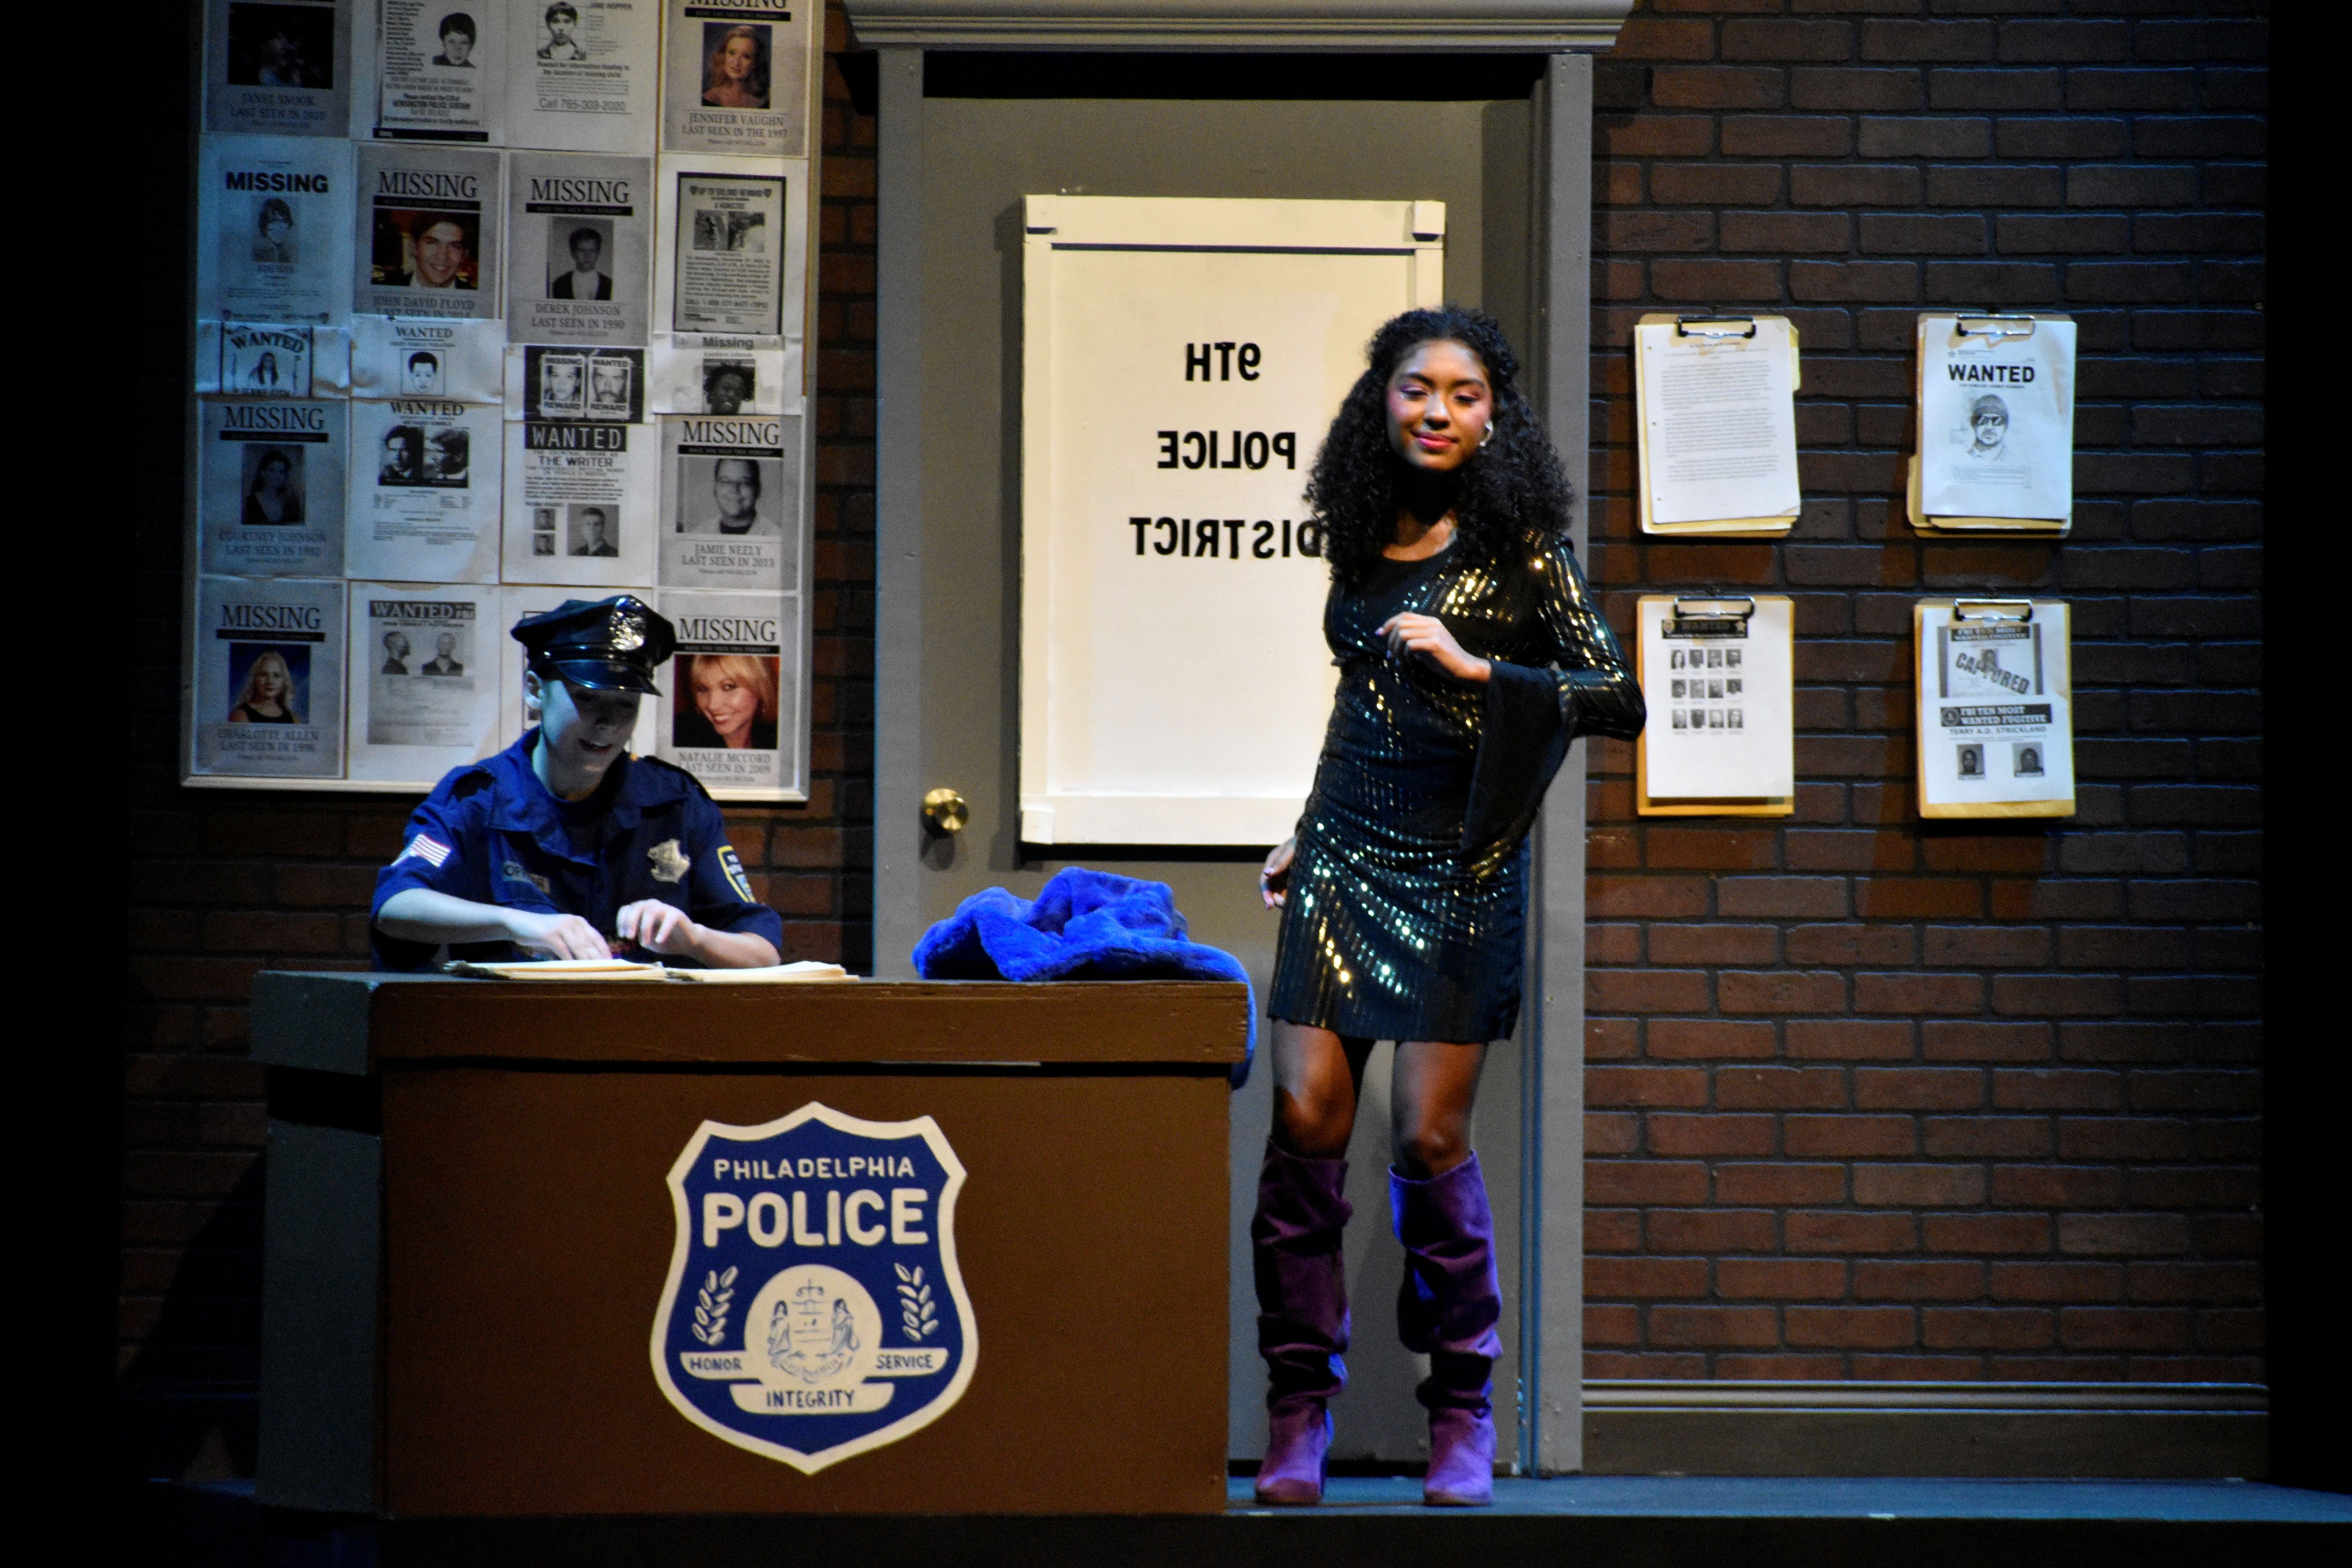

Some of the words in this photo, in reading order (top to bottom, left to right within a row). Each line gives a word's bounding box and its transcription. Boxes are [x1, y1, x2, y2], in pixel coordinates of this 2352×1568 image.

[230, 105, 255, 117] LAST
[259, 108, 285, 118] SEEN
[289, 109, 300, 119] IN
[690, 113, 737, 125] JENNIFER
[740, 115, 783, 126] VAUGHN
[682, 125, 704, 134] LAST
[708, 126, 731, 135] SEEN
[733, 127, 744, 136] IN
[746, 128, 764, 137] THE
[226, 171, 329, 193] MISSING
[378, 171, 478, 198] MISSING
[531, 178, 630, 203] MISSING
[403, 297, 438, 308] DAVID
[440, 299, 475, 310] FLOYD
[536, 303, 570, 314] DEREK
[572, 305, 620, 316] JOHNSON
[532, 317, 557, 327] LAST
[559, 318, 585, 328] SEEN
[588, 319, 599, 328] IN
[395, 327, 454, 338] WANTED
[230, 332, 305, 353] WANTED
[703, 336, 754, 350] Missing
[545, 357, 583, 365] MISSING
[592, 359, 628, 367] WANTED
[1948, 364, 2035, 383] WANTED
[390, 401, 465, 416] WANTED
[544, 401, 581, 410] REWARD
[590, 403, 626, 411] REWARD
[223, 406, 325, 430] MISSING
[532, 426, 622, 449] WANTED
[682, 420, 780, 445] MISSING
[539, 456, 563, 466] THE
[566, 457, 614, 467] WRITER
[226, 545, 250, 555] LAST
[255, 546, 281, 555] SEEN
[283, 546, 295, 555] IN
[695, 544, 726, 556] JAMIE
[729, 545, 763, 555] NEELY
[682, 555, 708, 565] LAST
[710, 556, 736, 566] SEEN
[738, 557, 749, 567] IN
[373, 602, 454, 618] WANTED
[221, 605, 321, 629] MISSING
[679, 618, 777, 642] MISSING
[1956, 653, 2031, 695] CAPTURED
[1960, 707, 1976, 716] FBI
[1978, 707, 1996, 715] TEN
[1997, 706, 2025, 714] MOST
[1960, 716, 2001, 724] WANTED
[2002, 714, 2047, 724] FUGITIVE
[220, 741, 246, 751] LAST
[249, 742, 276, 751] SEEN
[278, 742, 290, 751] IN
[679, 752, 725, 762] NATALIE
[727, 753, 771, 763] MCCORD
[706, 763, 731, 773] SEEN
[734, 764, 745, 773] IN
[714, 1156, 915, 1180] PHILADELPHIA
[702, 1188, 929, 1248] POLICE
[690, 1357, 743, 1372] HONOR
[875, 1355, 934, 1370] SERVICE
[766, 1389, 855, 1408] INTEGRITY
